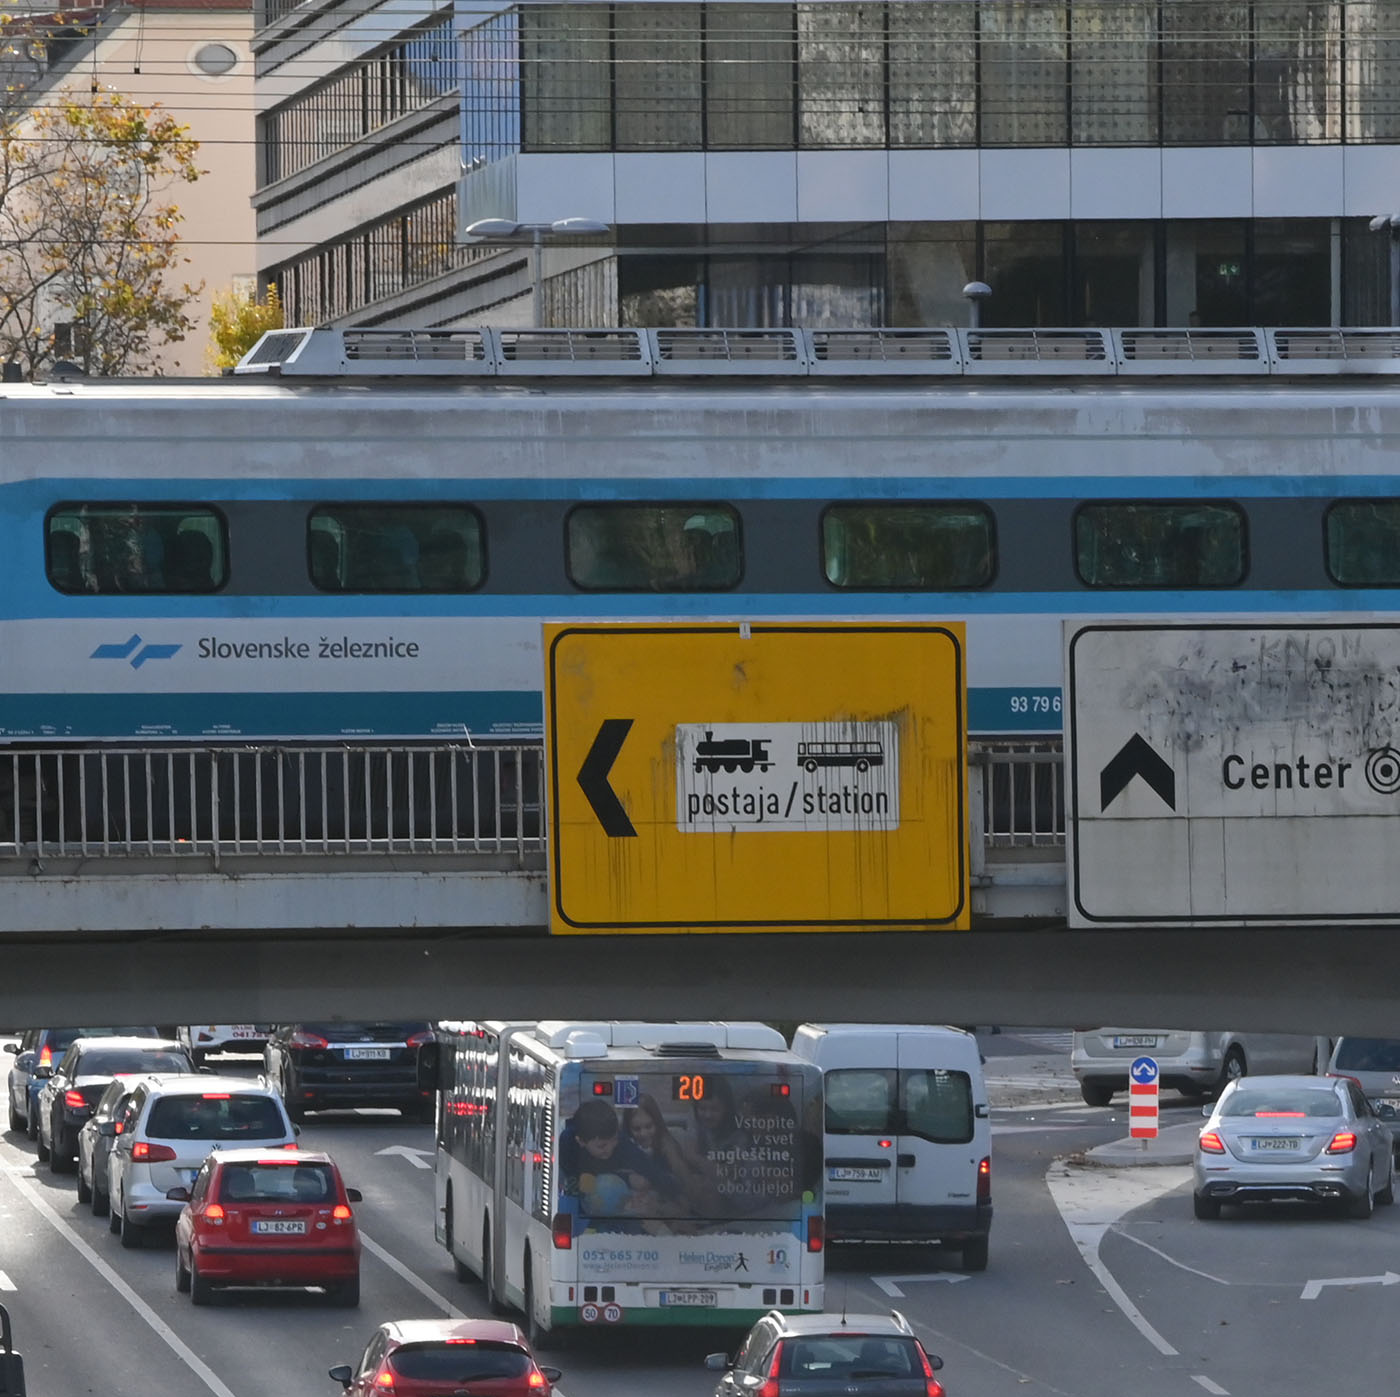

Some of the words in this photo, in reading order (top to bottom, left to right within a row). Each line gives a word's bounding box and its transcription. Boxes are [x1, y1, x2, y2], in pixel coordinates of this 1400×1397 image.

[198, 637, 310, 659] Slovenske
[318, 636, 420, 659] železnice
[1011, 696, 1028, 712] 93
[1032, 696, 1050, 712] 79
[1222, 754, 1352, 790] Center
[679, 1075, 704, 1100] 20
[734, 1115, 795, 1131] Vstopite
[753, 1136, 761, 1144] v
[765, 1133, 794, 1145] svet
[1257, 1140, 1267, 1148] LJ
[707, 1147, 794, 1165] angleščine,
[716, 1163, 728, 1176] ki
[734, 1164, 747, 1180] jo
[752, 1164, 794, 1176] otroci
[836, 1169, 847, 1178] LJ
[258, 1223, 270, 1231] LJ
[667, 1291, 678, 1303] LJ
[585, 1309, 596, 1318] 50
[607, 1309, 618, 1318] 70
